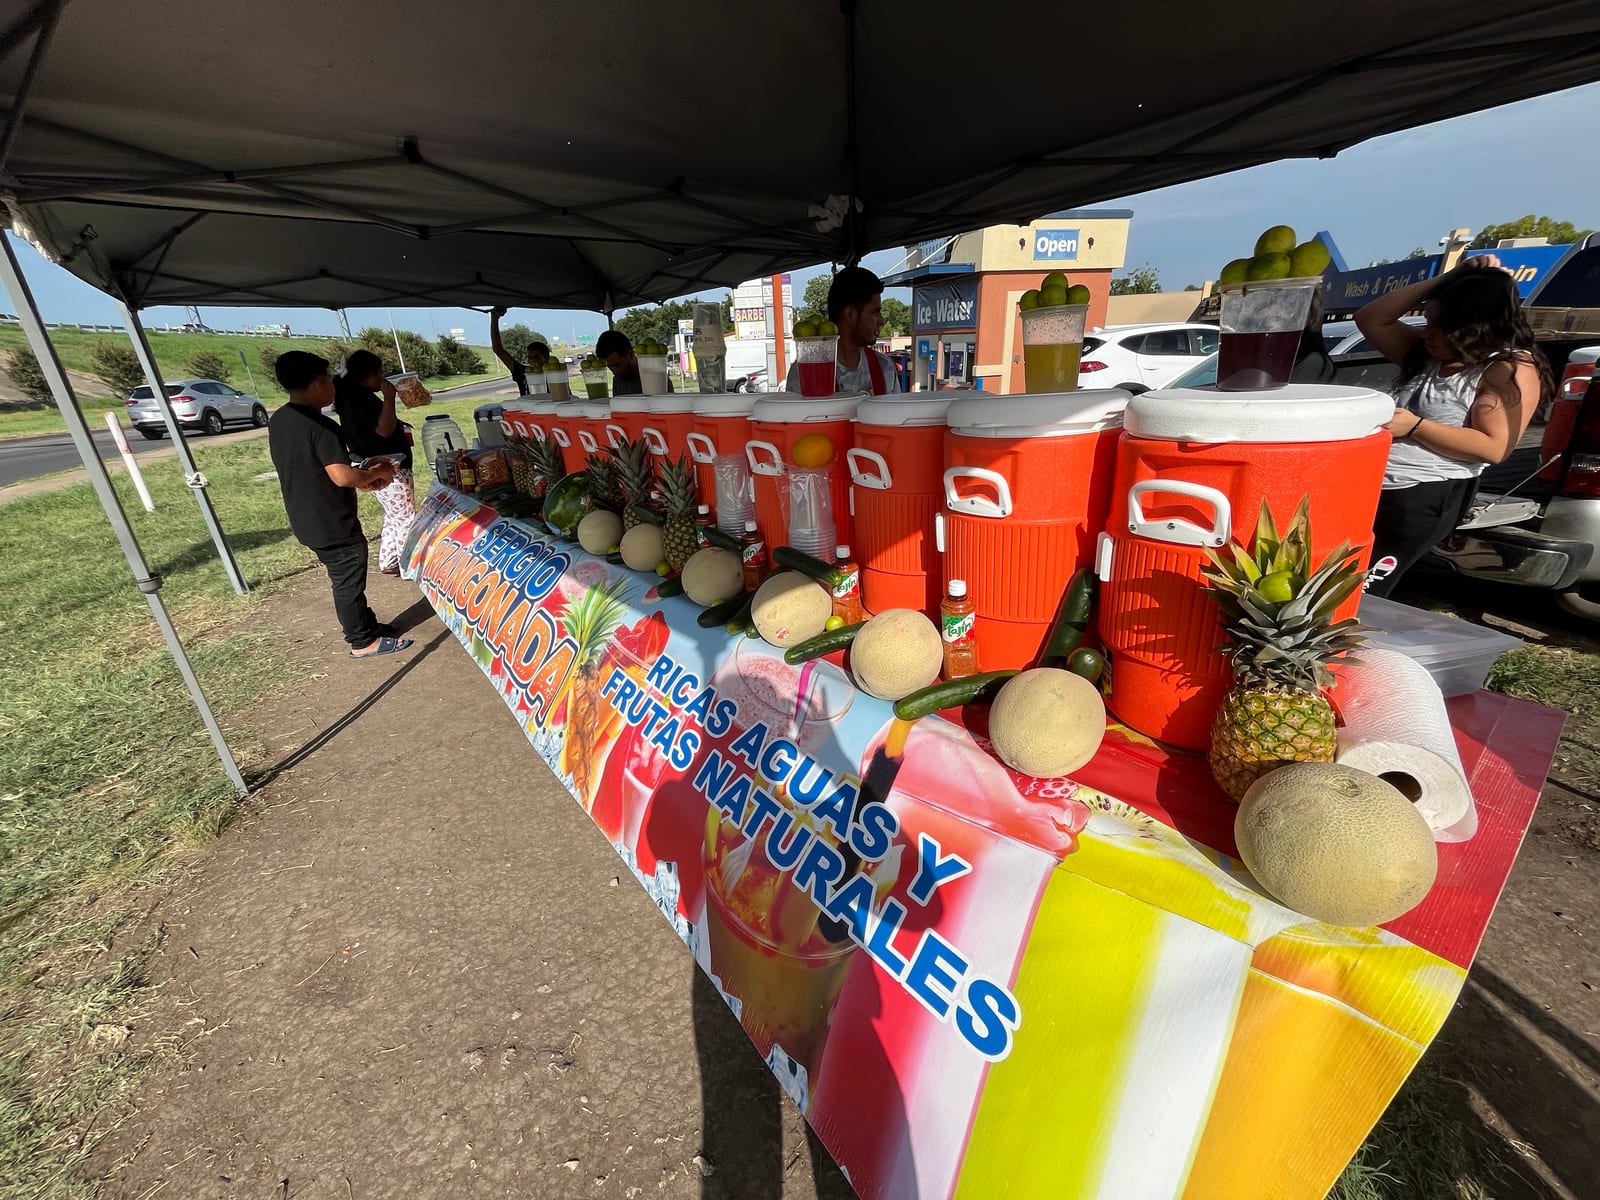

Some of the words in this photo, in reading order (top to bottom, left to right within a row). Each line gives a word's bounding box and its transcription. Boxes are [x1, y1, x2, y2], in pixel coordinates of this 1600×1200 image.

[1036, 236, 1077, 257] Open
[917, 303, 932, 325] Ice
[936, 298, 974, 323] Water
[1344, 281, 1370, 298] Wash
[1371, 277, 1381, 295] &
[1382, 273, 1411, 293] Fold
[735, 308, 765, 321] BARBE
[474, 520, 571, 600] SERGIO
[422, 538, 579, 727] MANGONADA
[646, 654, 737, 737] RICAS
[731, 721, 899, 861] AGUAS
[906, 832, 973, 906] Y
[601, 668, 700, 771] FRUTAS
[692, 751, 1021, 1062] NATURALES
